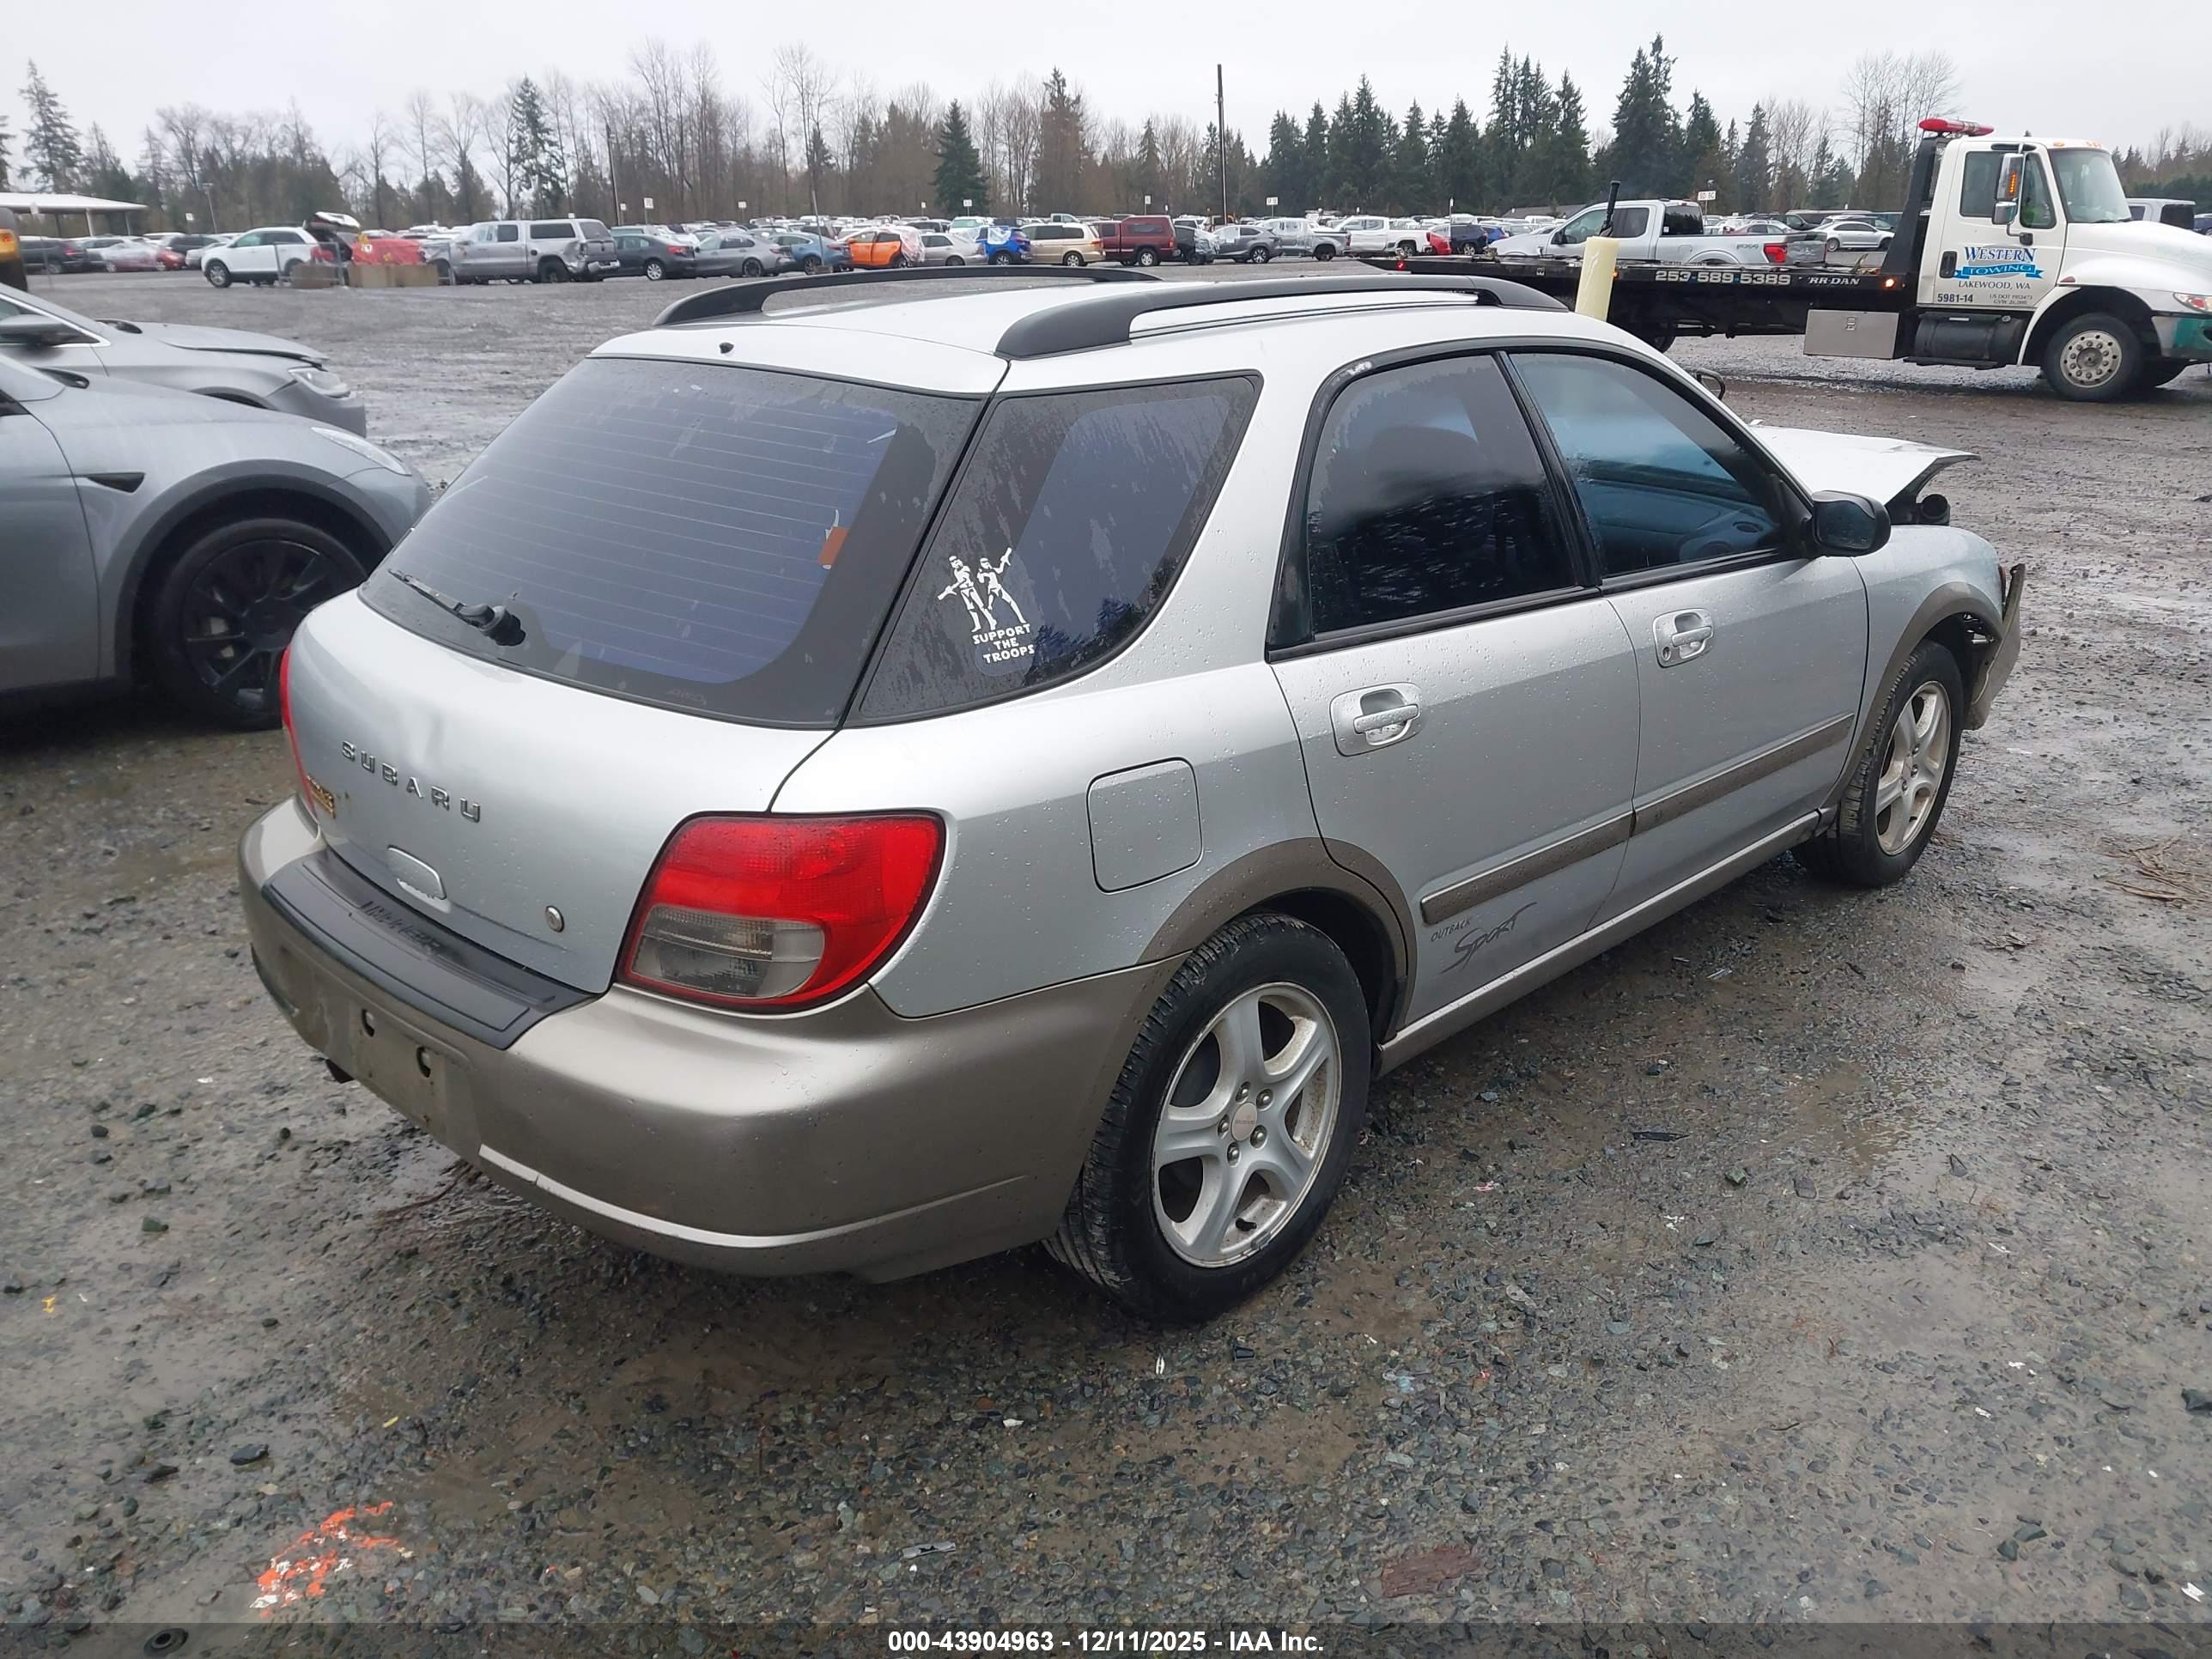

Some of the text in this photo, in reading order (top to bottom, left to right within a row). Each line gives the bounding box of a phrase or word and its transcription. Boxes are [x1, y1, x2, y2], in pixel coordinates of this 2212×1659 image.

[1964, 246, 2038, 263] WESTERN
[1970, 264, 2033, 275] TOWING
[1655, 270, 1791, 286] 253-589-5389
[1958, 280, 2013, 290] LAKEWOOD,
[1937, 293, 1973, 303] 5981-14
[972, 623, 1030, 645] SUPPORT
[994, 637, 1019, 650] THE
[982, 644, 1035, 664] TROOPS
[342, 740, 481, 823] SUBARU
[1431, 916, 1472, 941] OUTBACK
